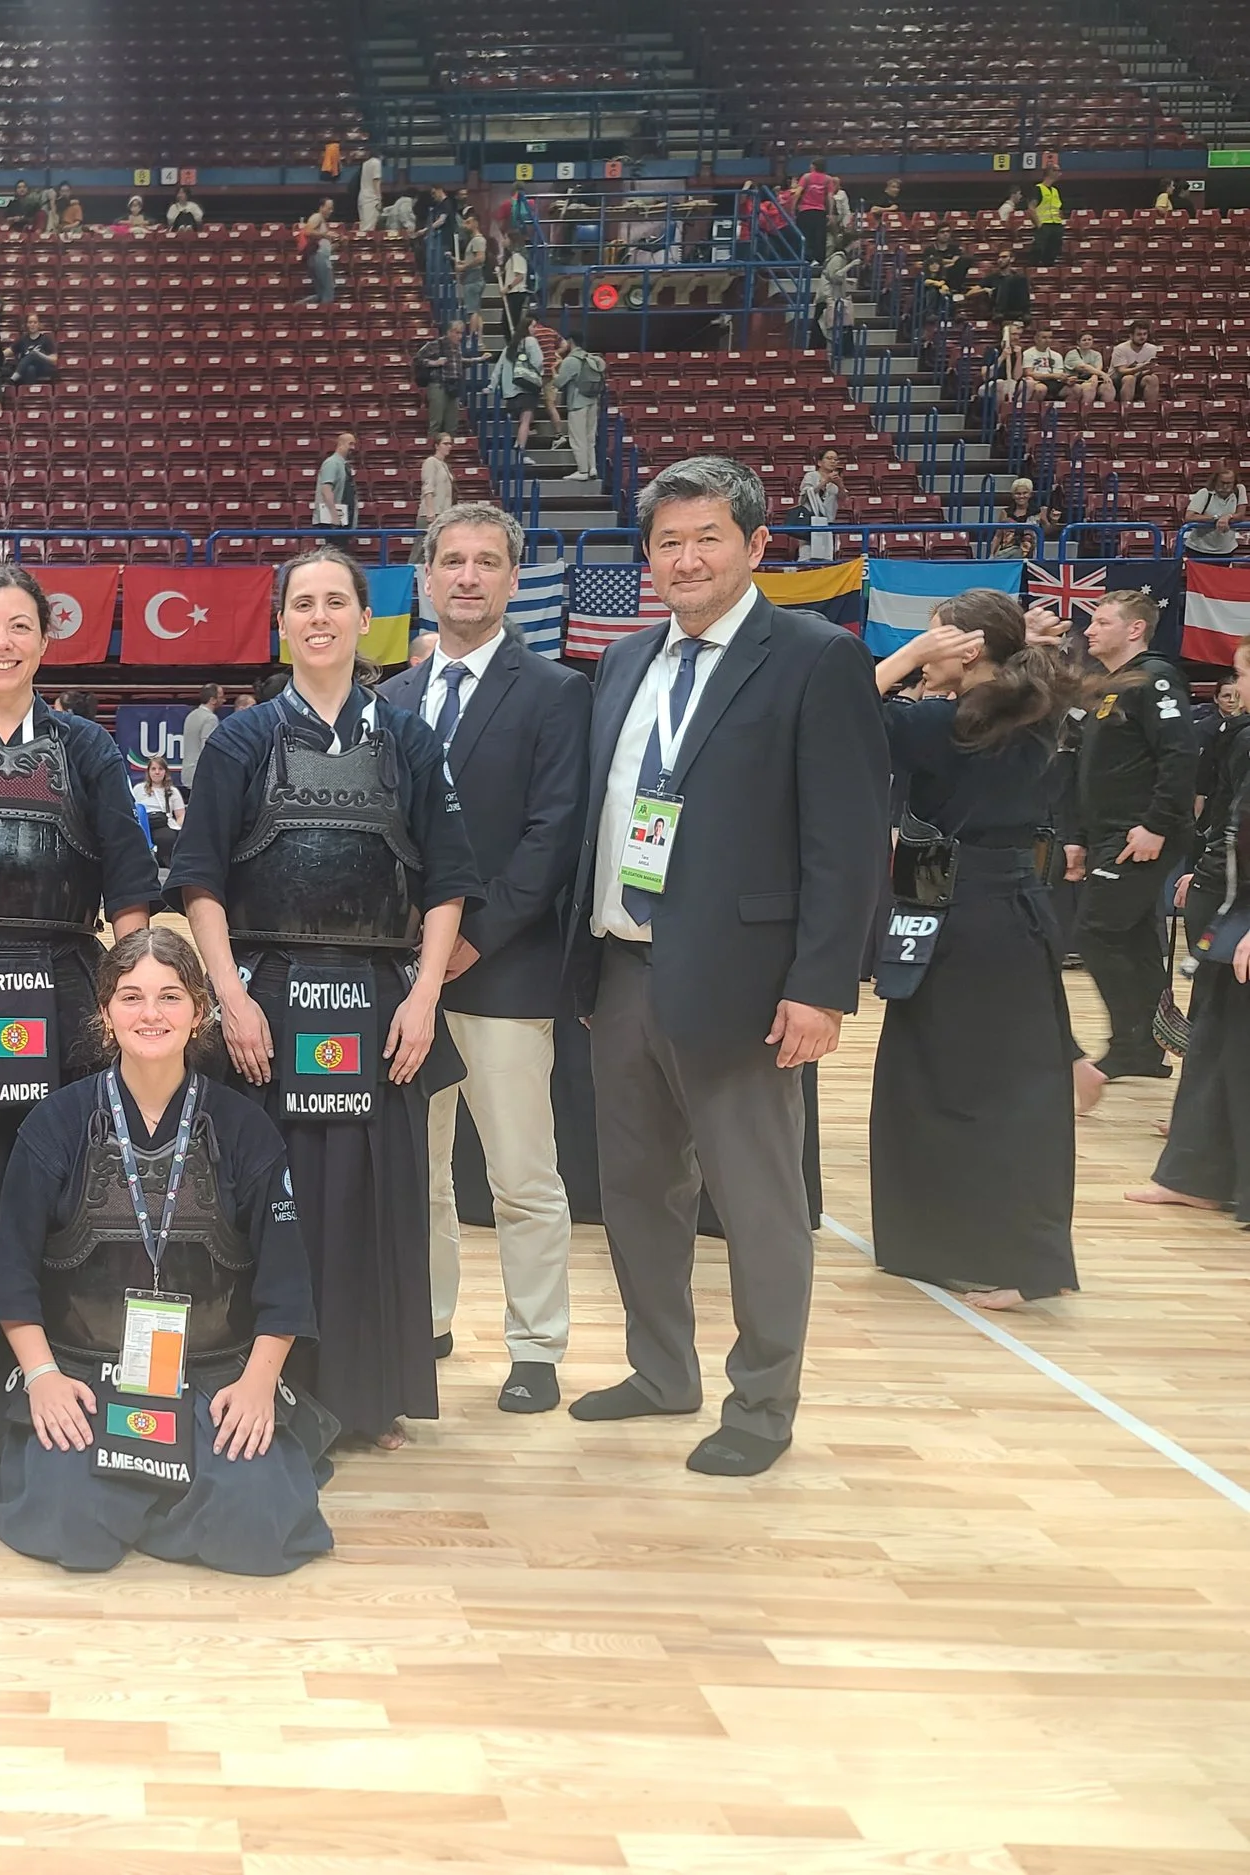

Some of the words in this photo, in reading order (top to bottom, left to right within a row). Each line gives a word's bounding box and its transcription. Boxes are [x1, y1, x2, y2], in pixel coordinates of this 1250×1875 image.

[140, 721, 184, 758] Un
[889, 915, 939, 937] NED
[900, 937, 917, 961] 2
[289, 981, 371, 1010] PORTUGAL
[286, 1092, 371, 1116] M.LOURENÇO
[277, 1375, 297, 1406] 6
[97, 1447, 191, 1483] B.MESQUITA
